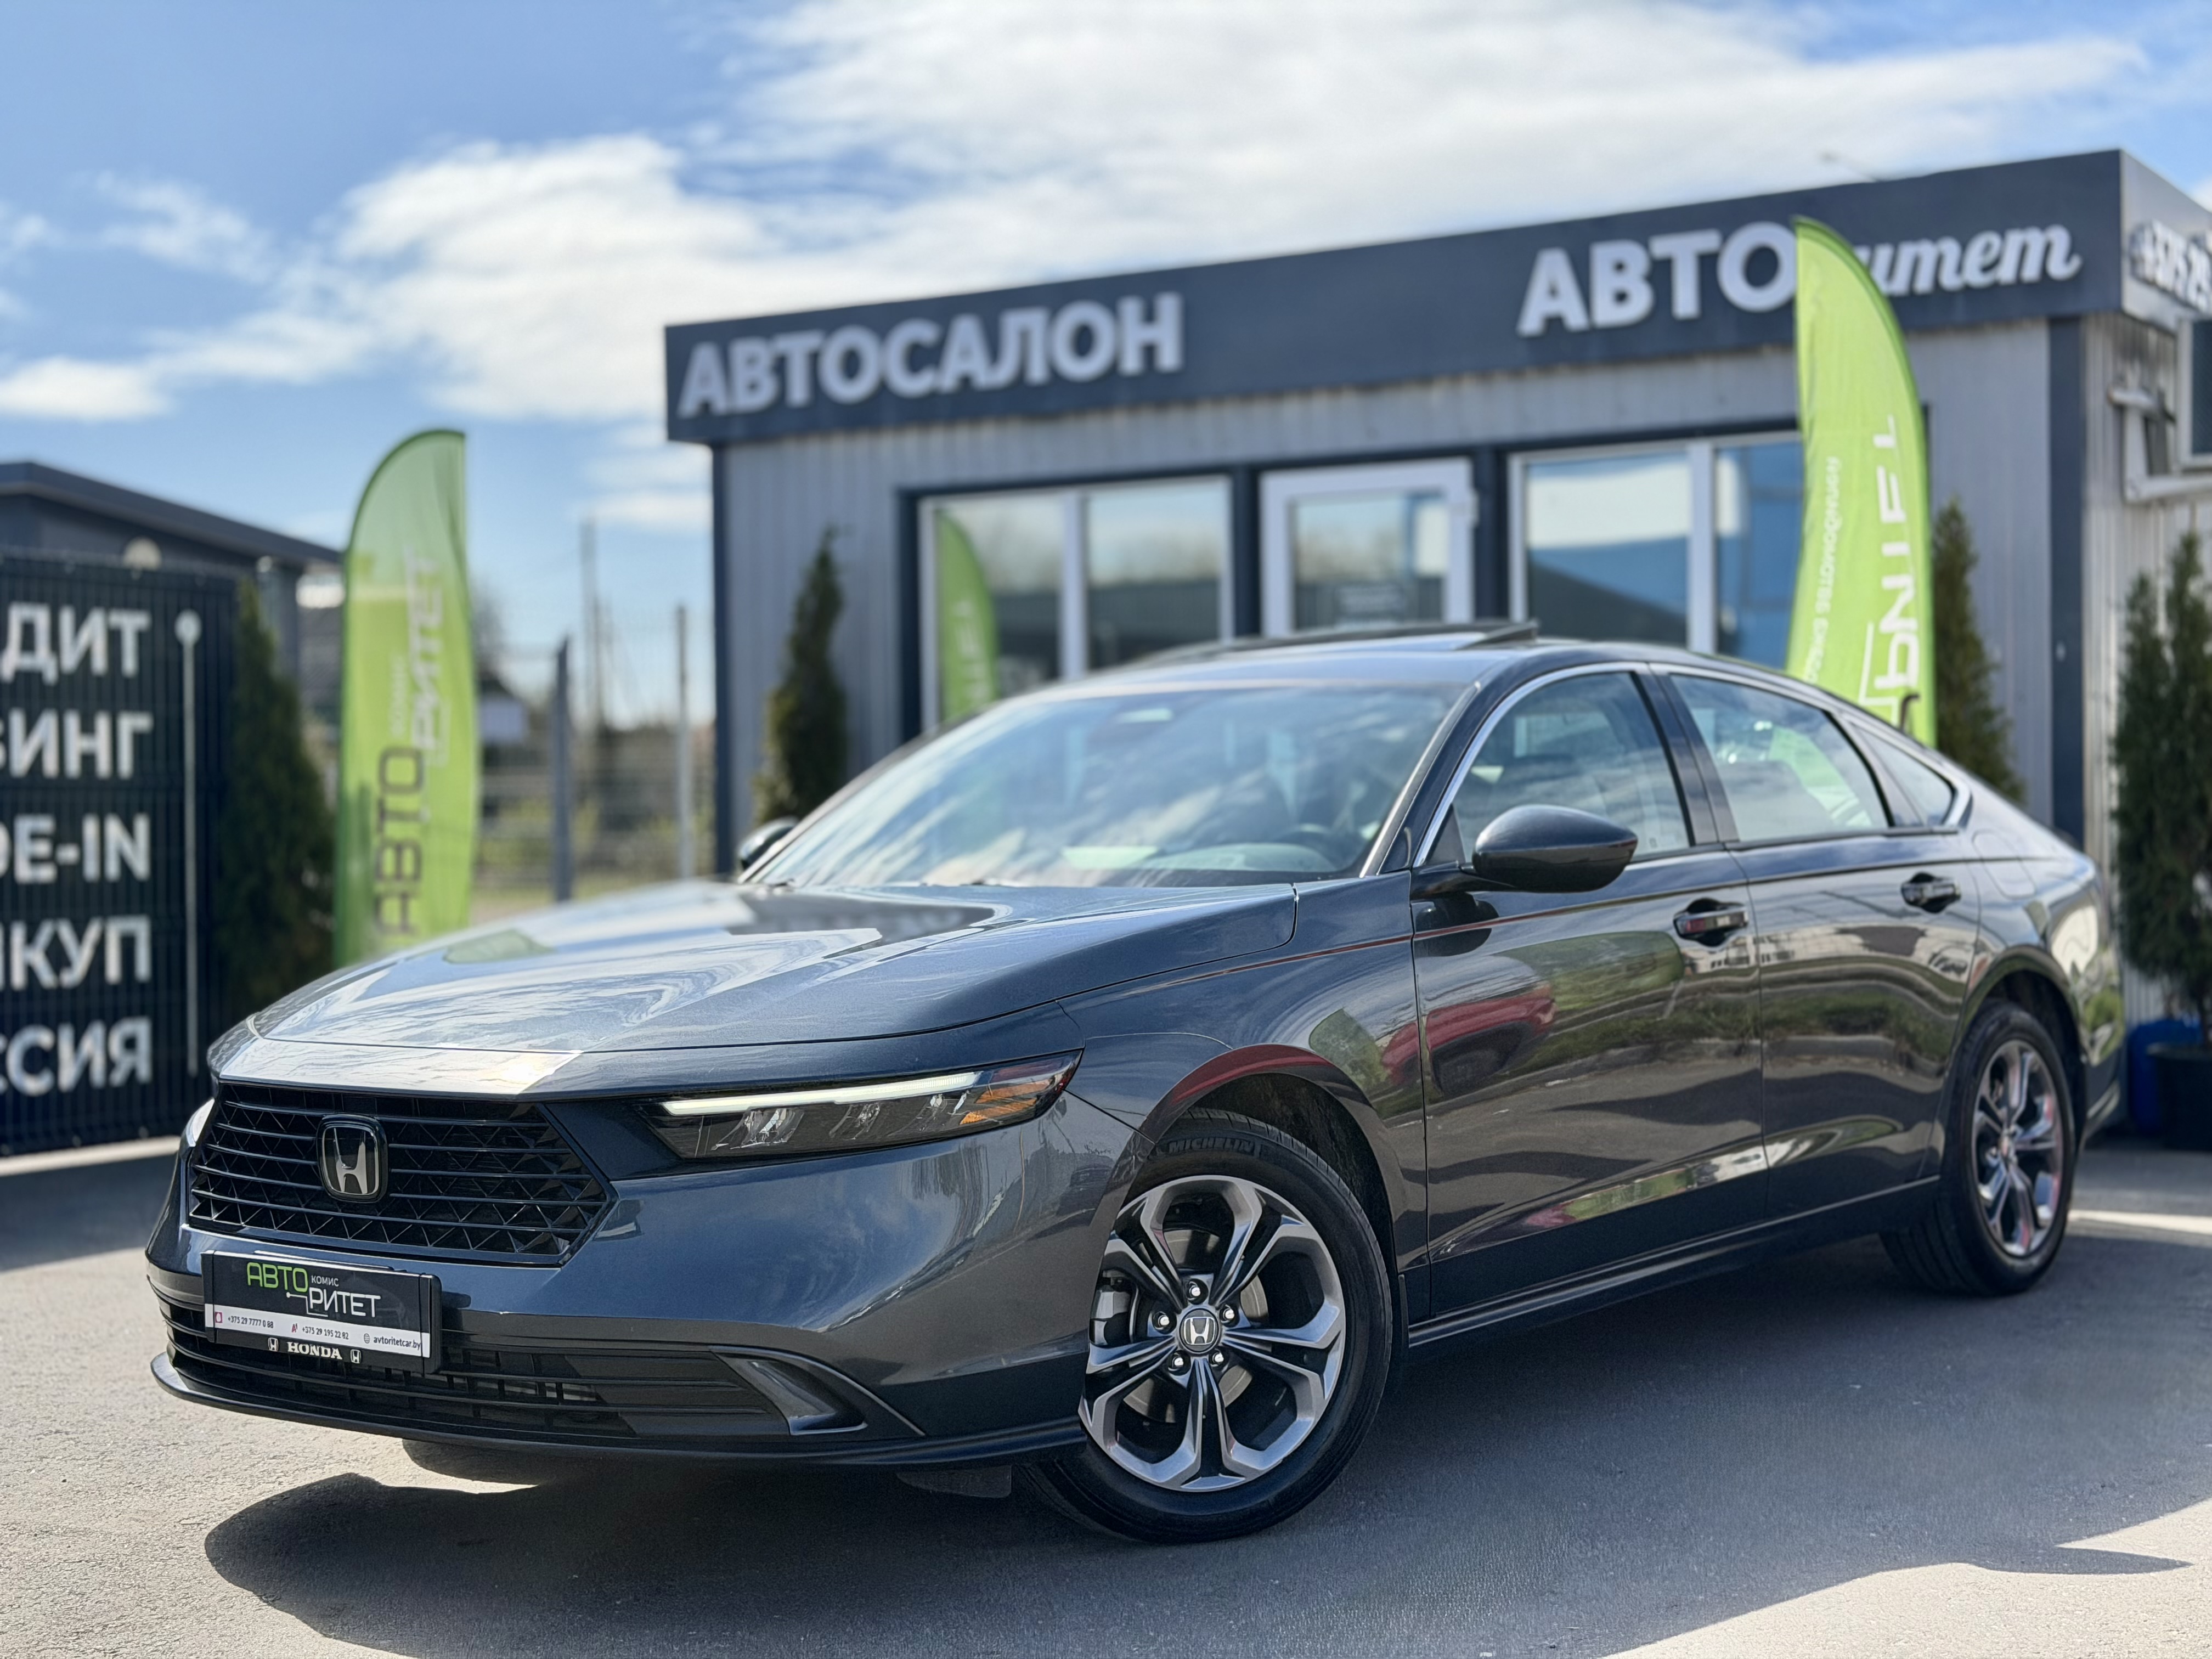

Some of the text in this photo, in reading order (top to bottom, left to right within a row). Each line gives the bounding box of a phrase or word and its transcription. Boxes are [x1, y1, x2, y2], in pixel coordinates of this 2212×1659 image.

[677, 292, 1184, 418] АВТОСАЛОН
[0, 708, 154, 780] ИНГ
[375, 746, 424, 936] АВТО
[0, 913, 153, 991] КУП
[0, 1017, 153, 1097] СИЯ
[247, 1262, 309, 1293] АВТО
[309, 1286, 381, 1318] РИТЕТ
[228, 1316, 240, 1324] +375
[241, 1317, 248, 1325] 29
[249, 1318, 262, 1327] 7777
[302, 1325, 314, 1335] +375
[324, 1328, 334, 1338] 195
[334, 1330, 342, 1339] 22
[286, 1341, 343, 1361] HONDA
[373, 1335, 421, 1351] avtoritetcar.by
